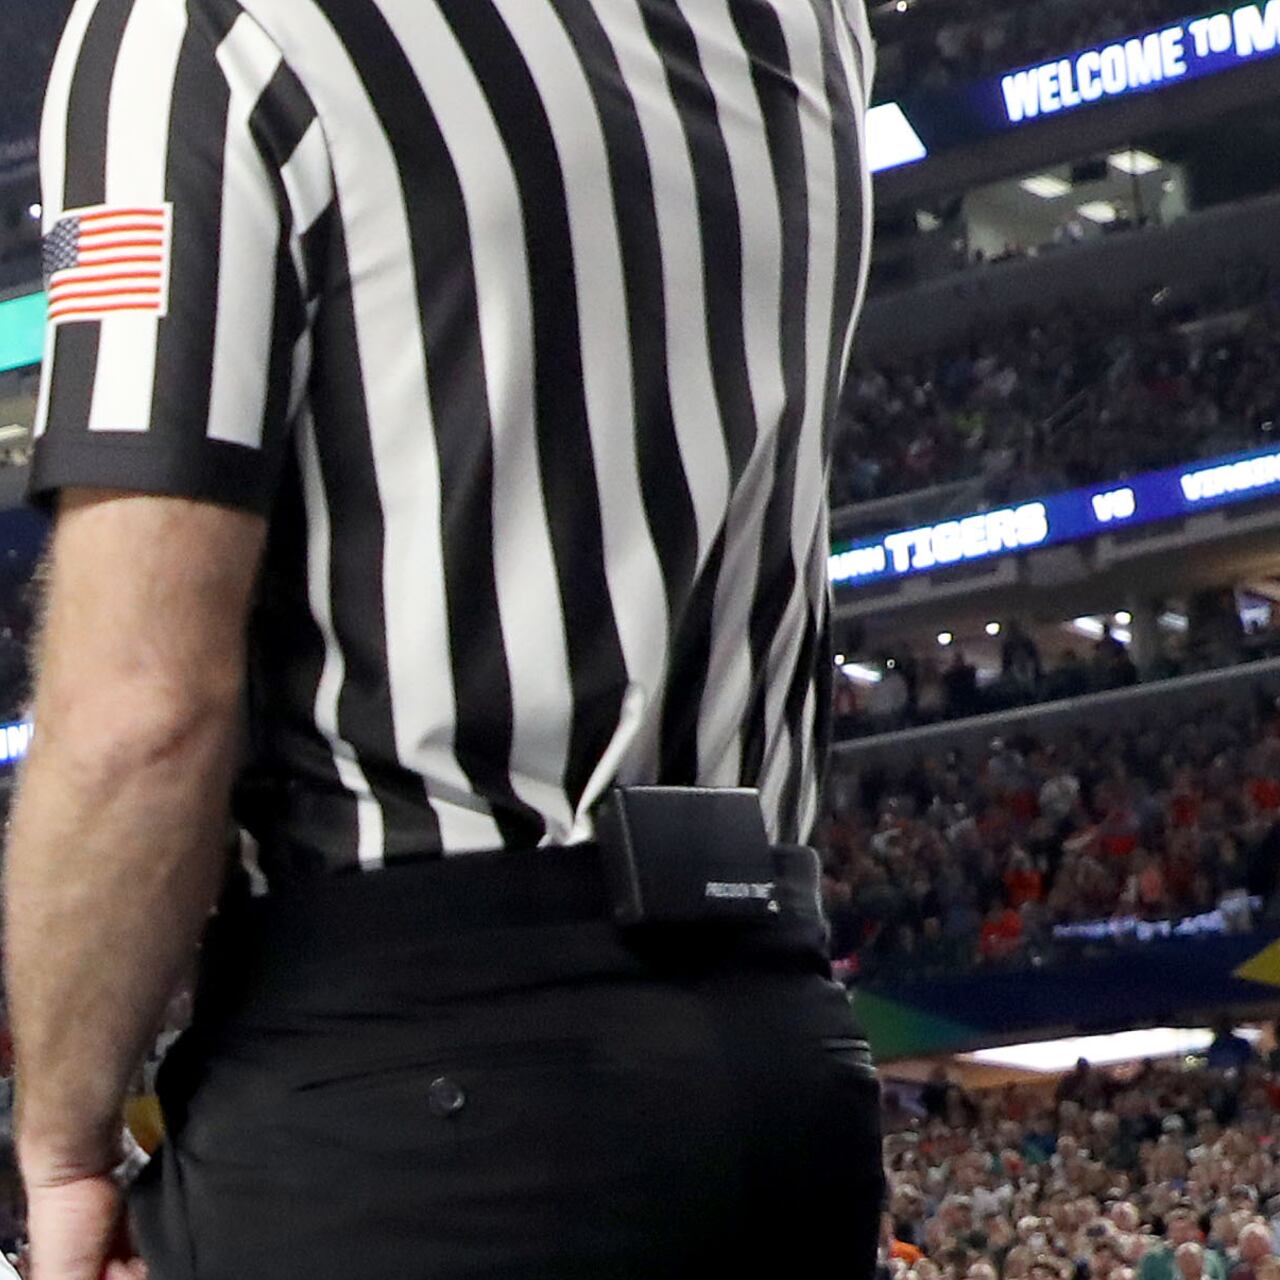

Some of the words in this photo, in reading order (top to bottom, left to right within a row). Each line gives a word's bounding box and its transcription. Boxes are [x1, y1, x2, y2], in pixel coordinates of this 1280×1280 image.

[1001, 25, 1187, 122] WELCOME
[1188, 13, 1233, 57] TO
[884, 502, 1048, 573] TIGERS
[1092, 487, 1135, 522] VS
